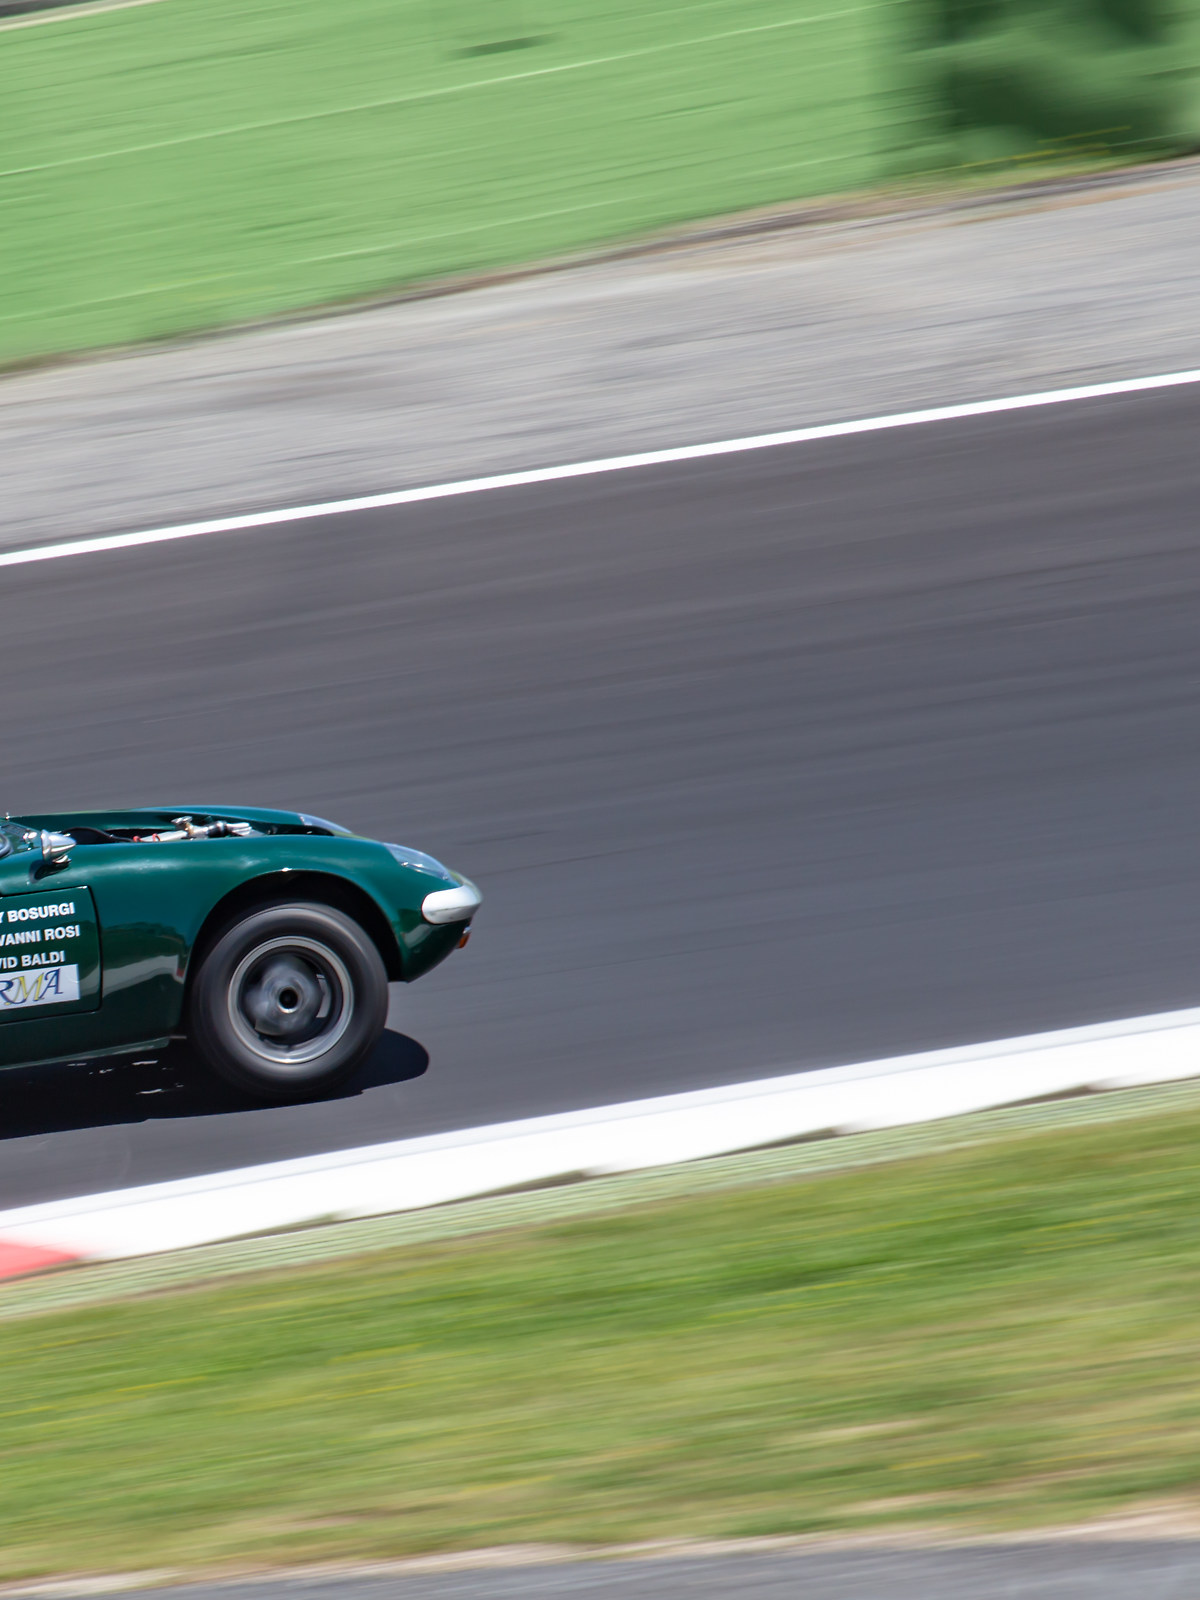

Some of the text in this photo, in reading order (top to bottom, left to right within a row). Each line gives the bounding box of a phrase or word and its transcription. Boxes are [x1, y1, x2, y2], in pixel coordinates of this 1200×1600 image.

[7, 902, 75, 923] BOSURGI
[44, 924, 80, 941] ROSI
[21, 950, 65, 967] BALDI
